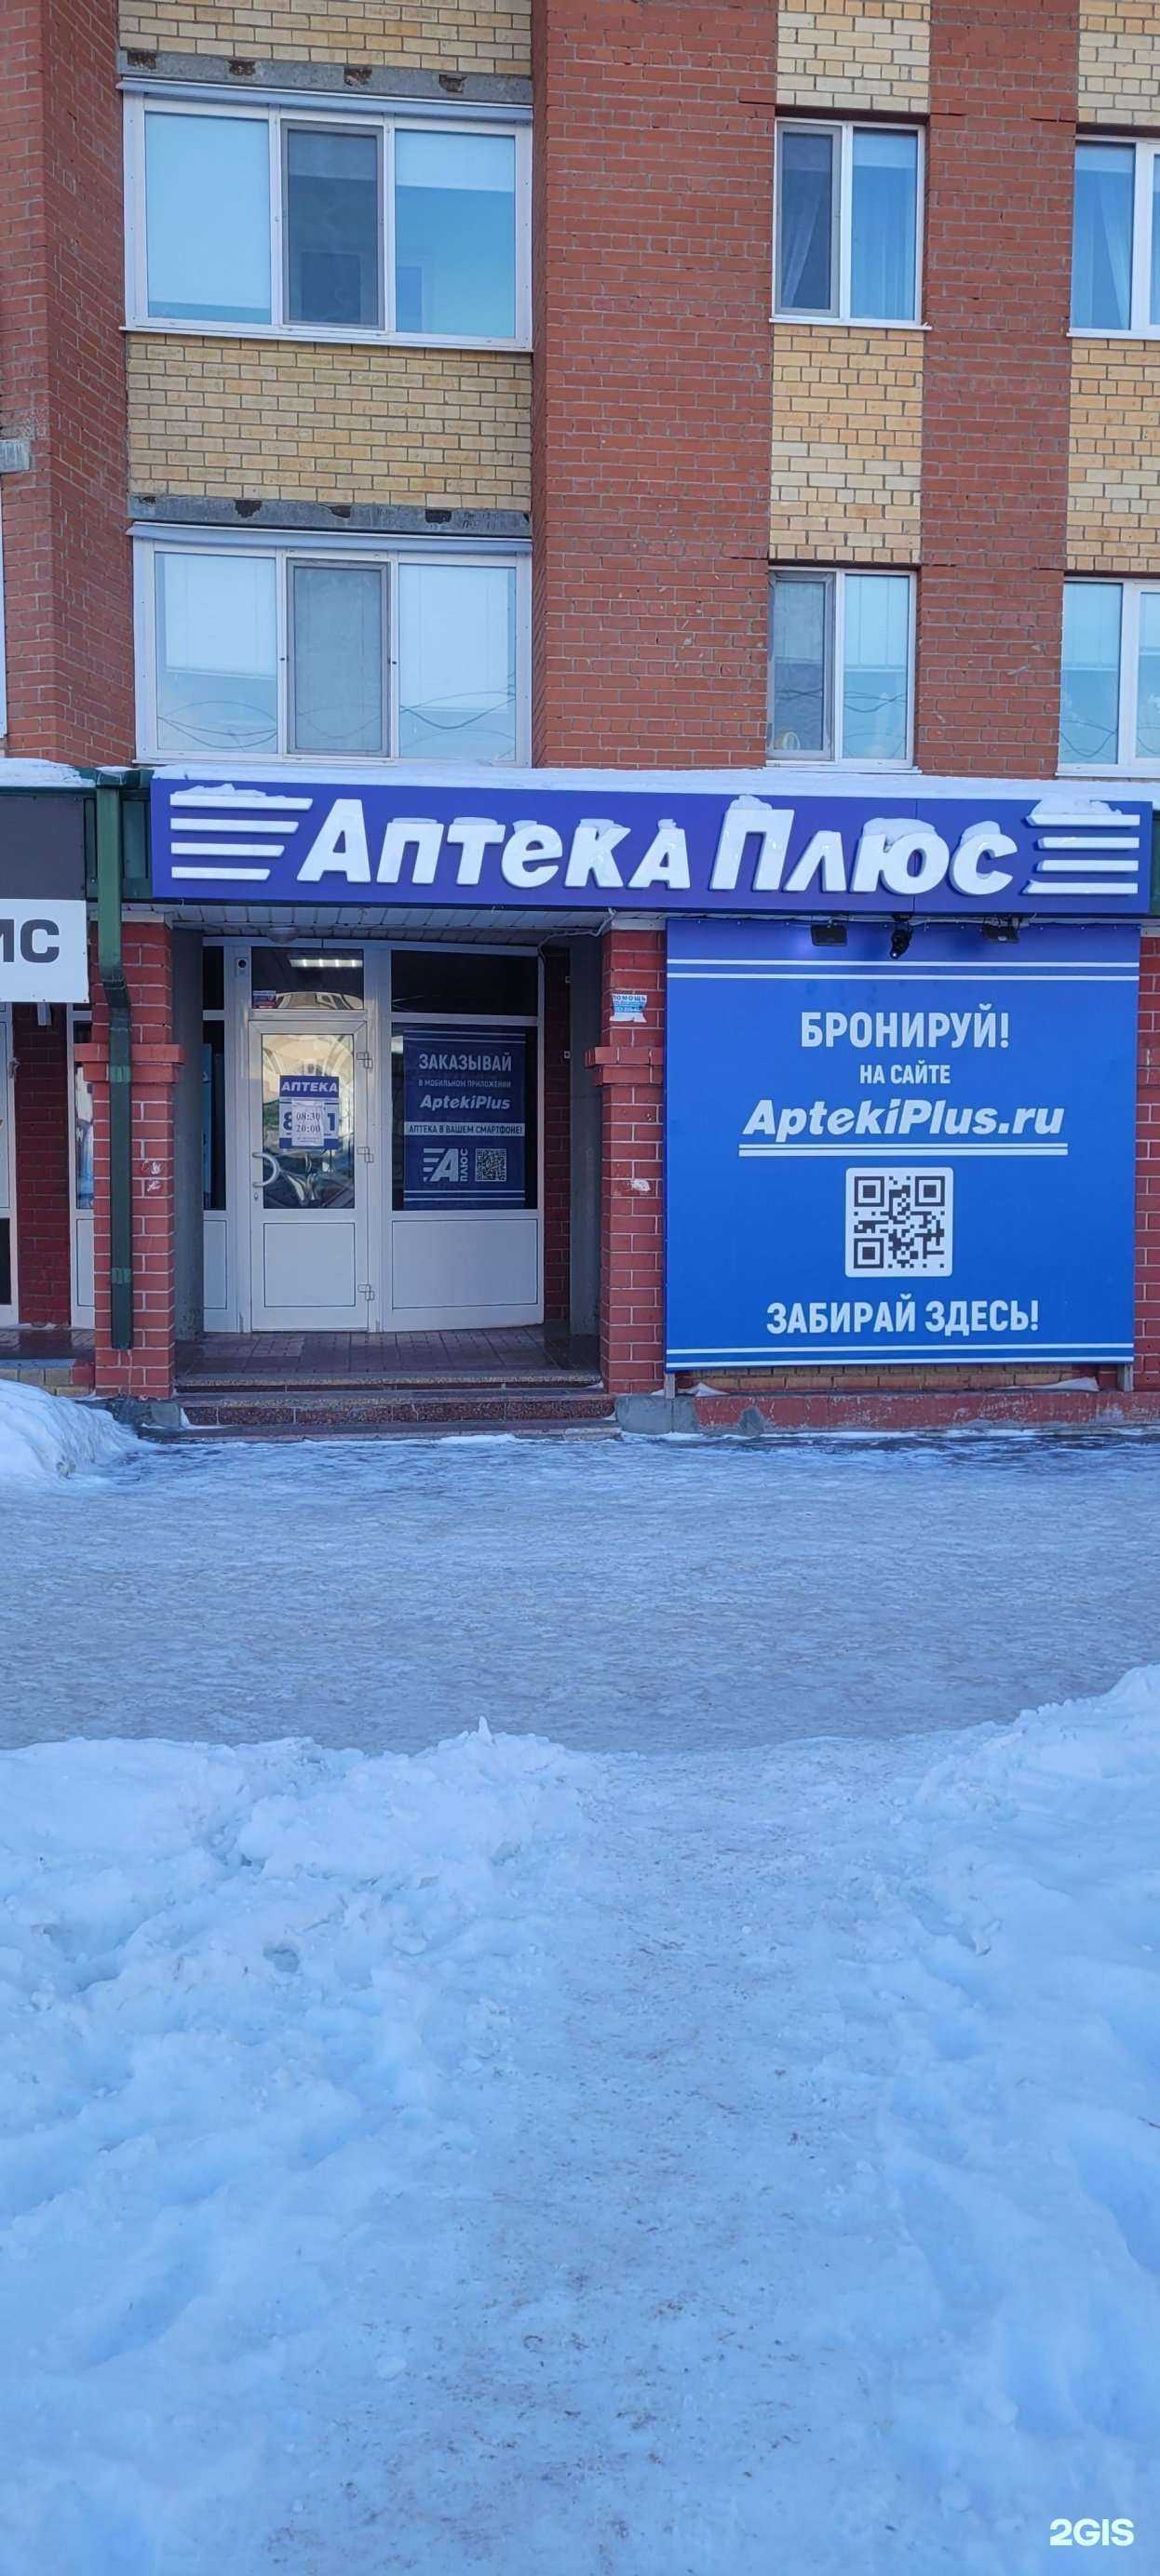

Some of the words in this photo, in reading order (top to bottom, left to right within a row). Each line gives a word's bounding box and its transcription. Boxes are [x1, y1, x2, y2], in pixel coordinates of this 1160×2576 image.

[801, 1002, 1009, 1048] БРОНИРУЙ!
[418, 1052, 512, 1072] ЗАКАЗЫВАЙ
[859, 1064, 885, 1084] НА
[890, 1059, 951, 1085] САЙТЕ
[281, 1081, 338, 1093] АПТЕКА
[425, 1079, 465, 1088] МОБИЛЬНОМ
[467, 1080, 511, 1088] ПРИЛОЖЕНИИ
[420, 1094, 511, 1111] AptekiPlus
[296, 1123, 321, 1133] 20:00
[409, 1124, 438, 1134] АПТЕКА
[438, 1124, 444, 1134] В
[446, 1124, 474, 1134] ВАШЕМ
[475, 1125, 522, 1134] СМАРТФОНЕ!
[742, 1098, 1065, 1143] AptekiPlus.ru
[766, 1293, 916, 1335] ЗАБИРАЙ
[924, 1299, 1039, 1336] ЗДЕСЬ!
